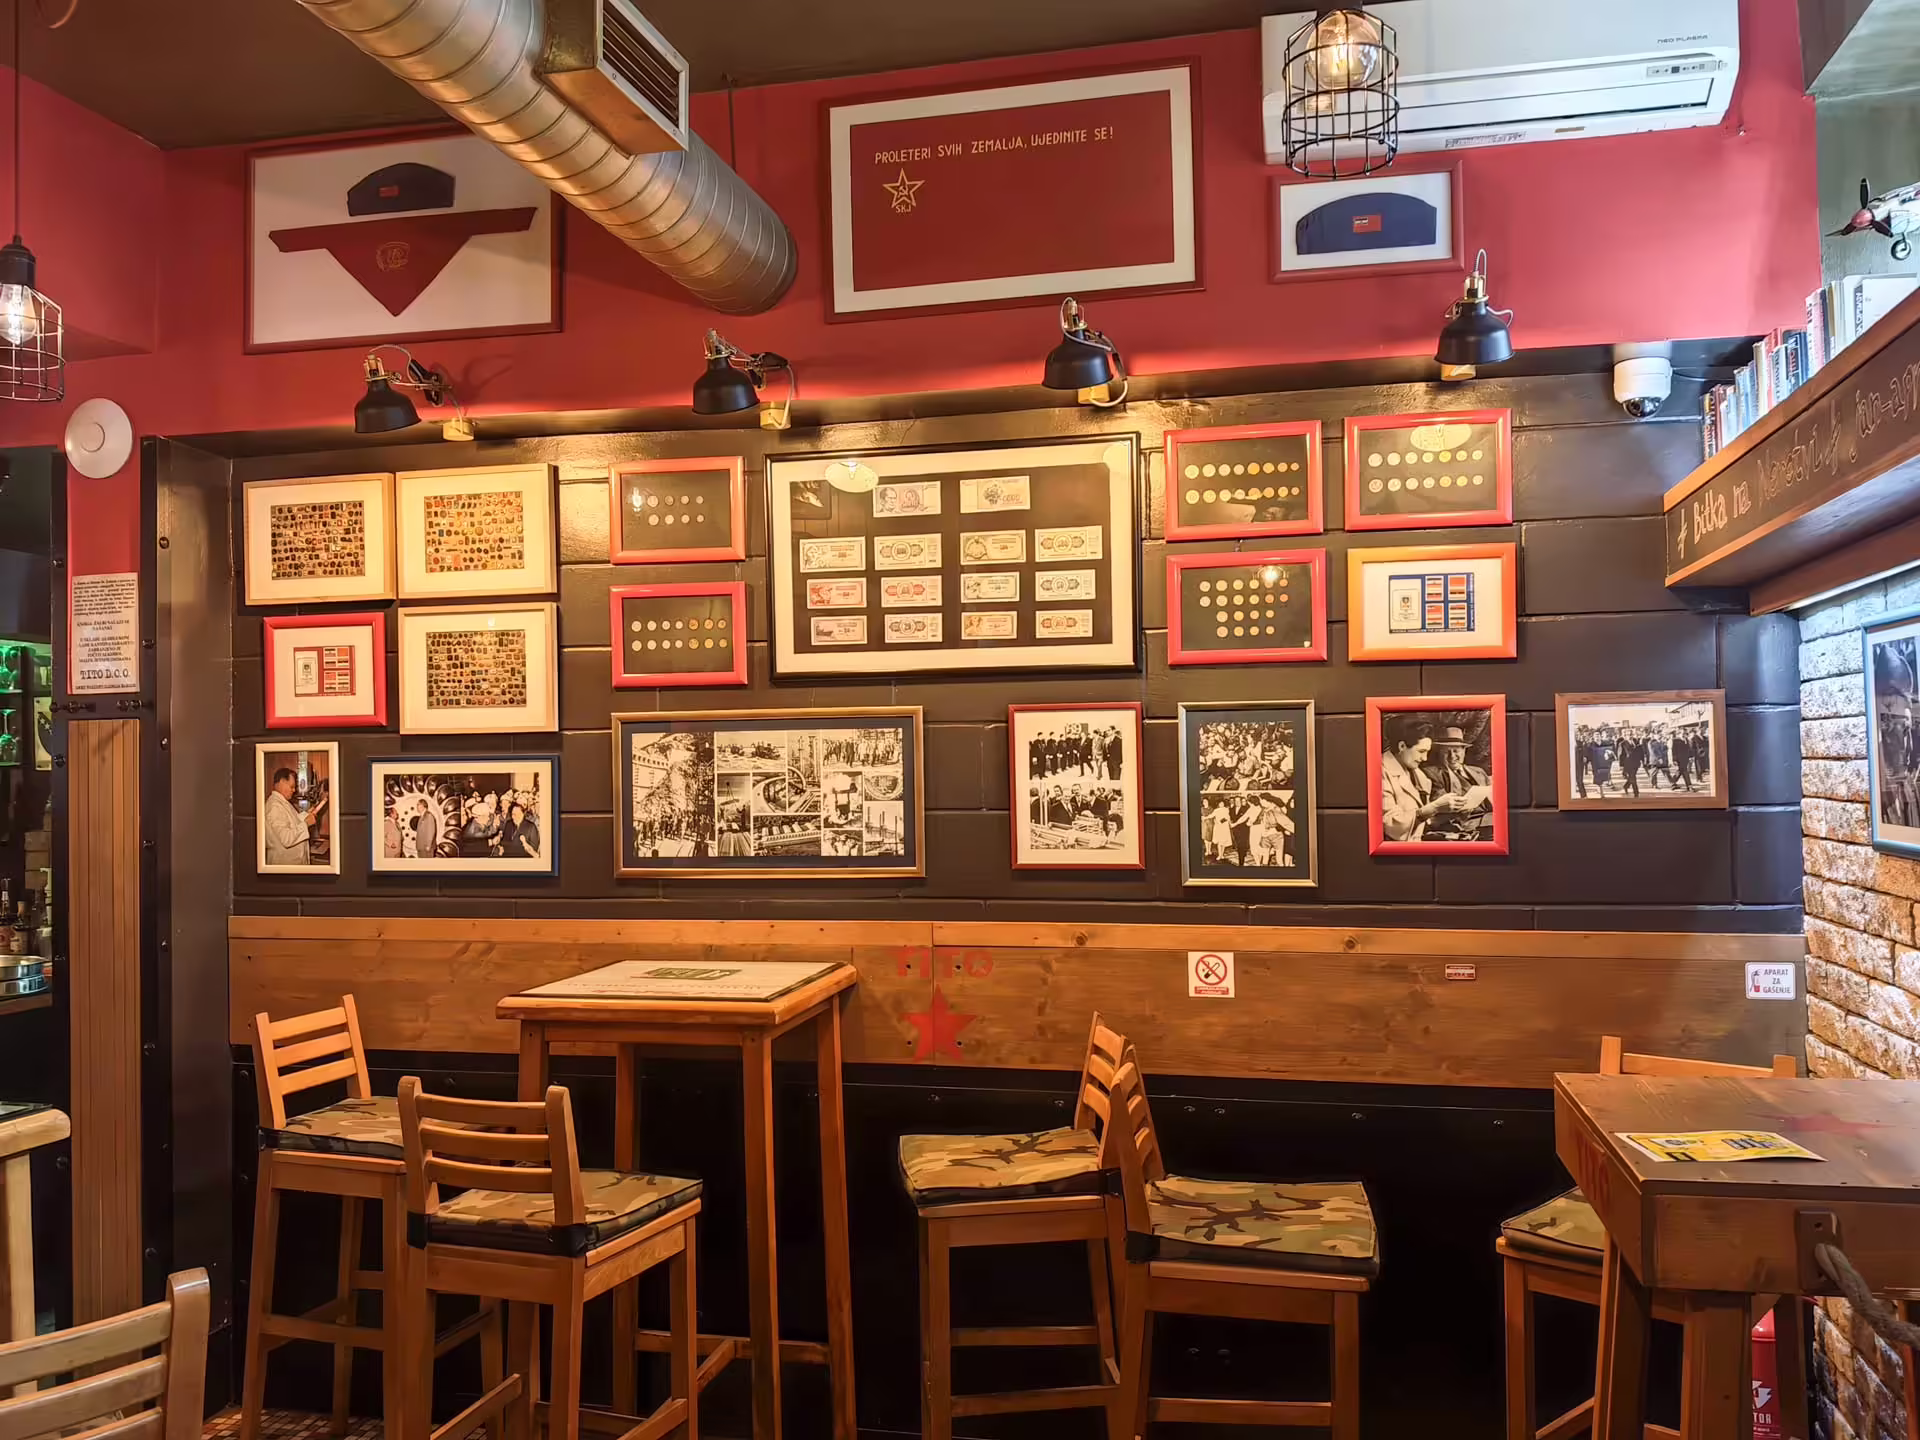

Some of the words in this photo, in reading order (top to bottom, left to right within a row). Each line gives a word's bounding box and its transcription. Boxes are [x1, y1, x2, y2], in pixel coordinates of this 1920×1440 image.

[874, 147, 931, 164] PROLETERI
[938, 143, 962, 157] SVIH
[971, 137, 1027, 154] ZEMALJA,
[1031, 130, 1087, 146] UJEDINITE
[1094, 126, 1114, 140] SE!
[895, 204, 912, 213] SKJ
[1693, 489, 1728, 545] Bitka
[1733, 480, 1751, 519] na
[80, 669, 103, 680] TITO
[888, 946, 993, 978] TITO
